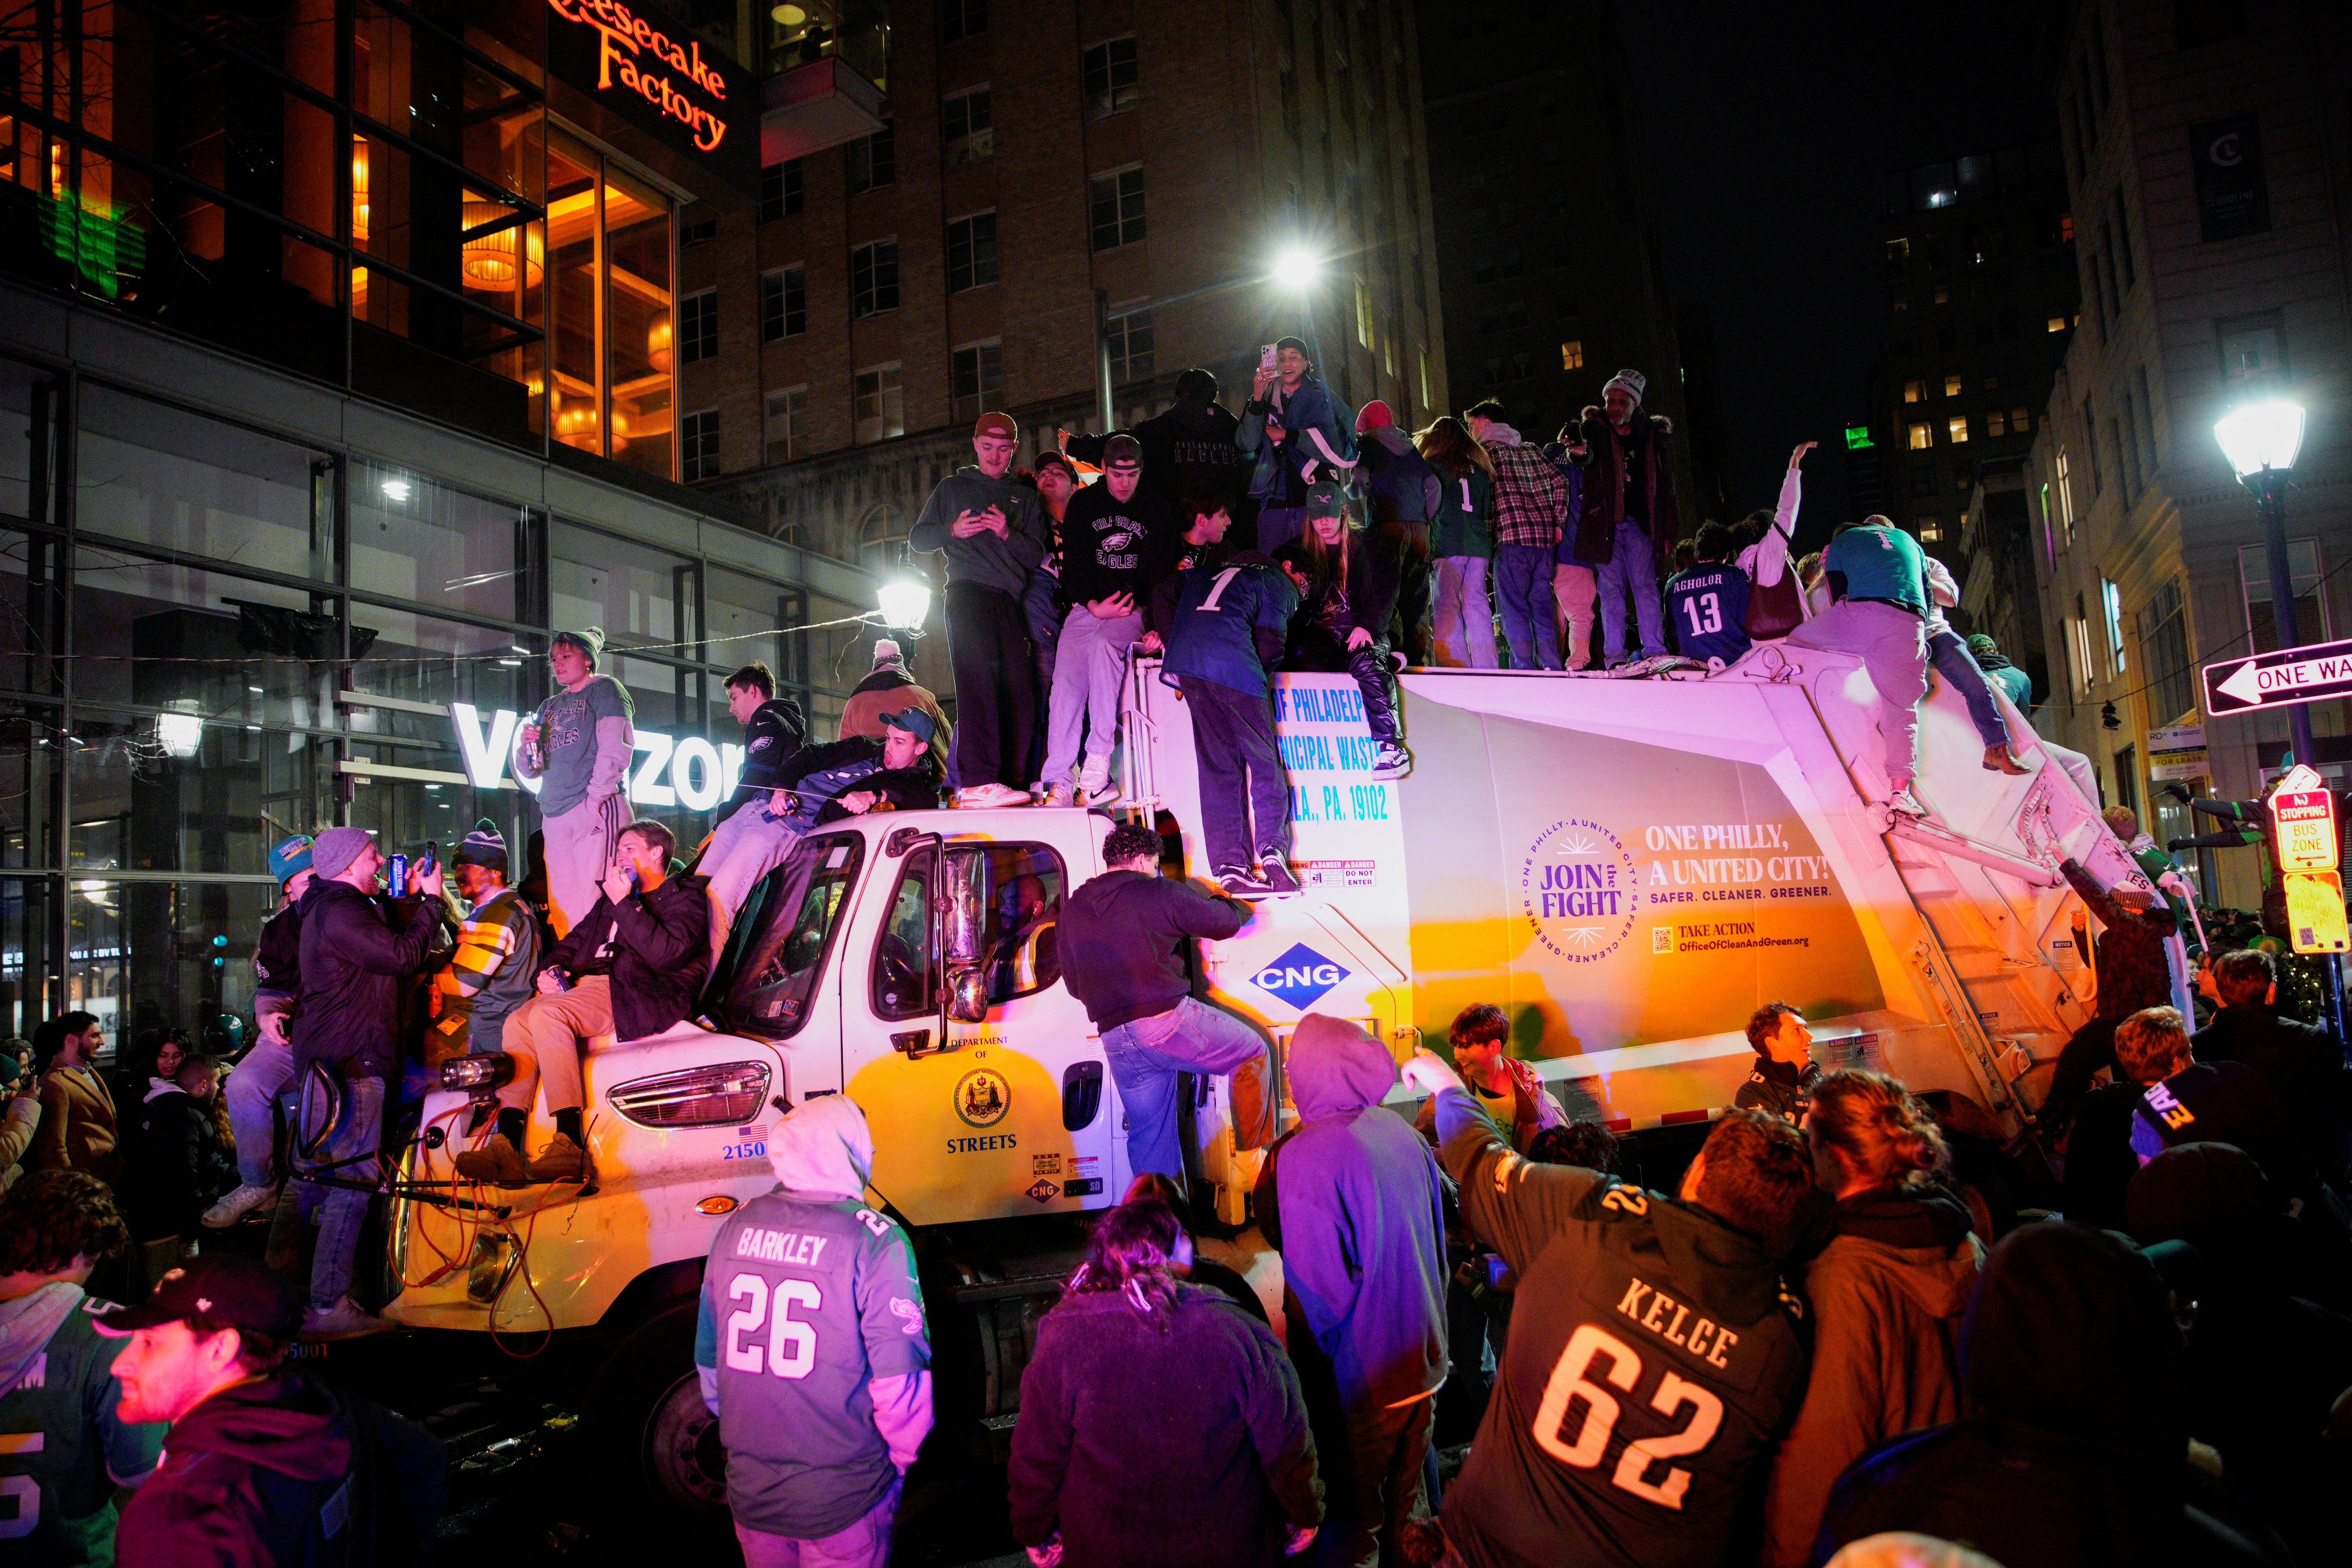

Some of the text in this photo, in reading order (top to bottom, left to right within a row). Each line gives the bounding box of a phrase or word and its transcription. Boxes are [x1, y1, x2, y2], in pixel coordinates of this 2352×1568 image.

[579, 6, 726, 151] Factory
[1458, 478, 1473, 513] 1
[1874, 531, 1894, 549] 1
[1196, 567, 1242, 612] 1
[1673, 574, 1723, 594] AGHOLOR
[1683, 592, 1723, 637] 13
[2257, 657, 2352, 689] ONE WA
[1291, 688, 1369, 722] PHILADELP
[2176, 756, 2202, 764] LEASE
[1323, 785, 1346, 821] PA.
[1350, 785, 1388, 821] 19102
[2280, 805, 2326, 820] STOPPING
[2293, 794, 2308, 806] NO
[1531, 821, 1563, 853] PHILLY
[1582, 819, 1622, 850] UNITED
[1645, 824, 1789, 852] ONE PHILLY,
[2293, 823, 2317, 836] BUS
[2292, 838, 2323, 852] ZONE
[1522, 857, 1532, 887] ONE
[1540, 863, 1617, 891] JOIN the
[1623, 853, 1638, 885] CITY
[1649, 855, 1829, 886] A UNITED CITY!
[1542, 890, 1622, 918] FIGHT
[1650, 886, 1832, 904] SAFER. CLEANER. GREENER.
[1524, 899, 1561, 956] GREENER
[1621, 895, 1638, 938] SAFER
[1678, 922, 1755, 938] TAKE ACTION
[1567, 941, 1619, 963] CLEANER
[1679, 936, 1809, 952] OfficeOfCleanAndGreen.org
[1256, 964, 1339, 989] CNG
[951, 1036, 1008, 1047] DEPARTMENT
[1860, 1035, 1877, 1043] DANGER
[947, 1134, 1017, 1154] STREETS
[1031, 1186, 1054, 1197] CNG
[1090, 1181, 1100, 1191] SD
[736, 1227, 827, 1267] BARKLEY
[726, 1272, 823, 1380] 26
[1616, 1277, 1739, 1369] KELCE
[1533, 1322, 1725, 1511] 62
